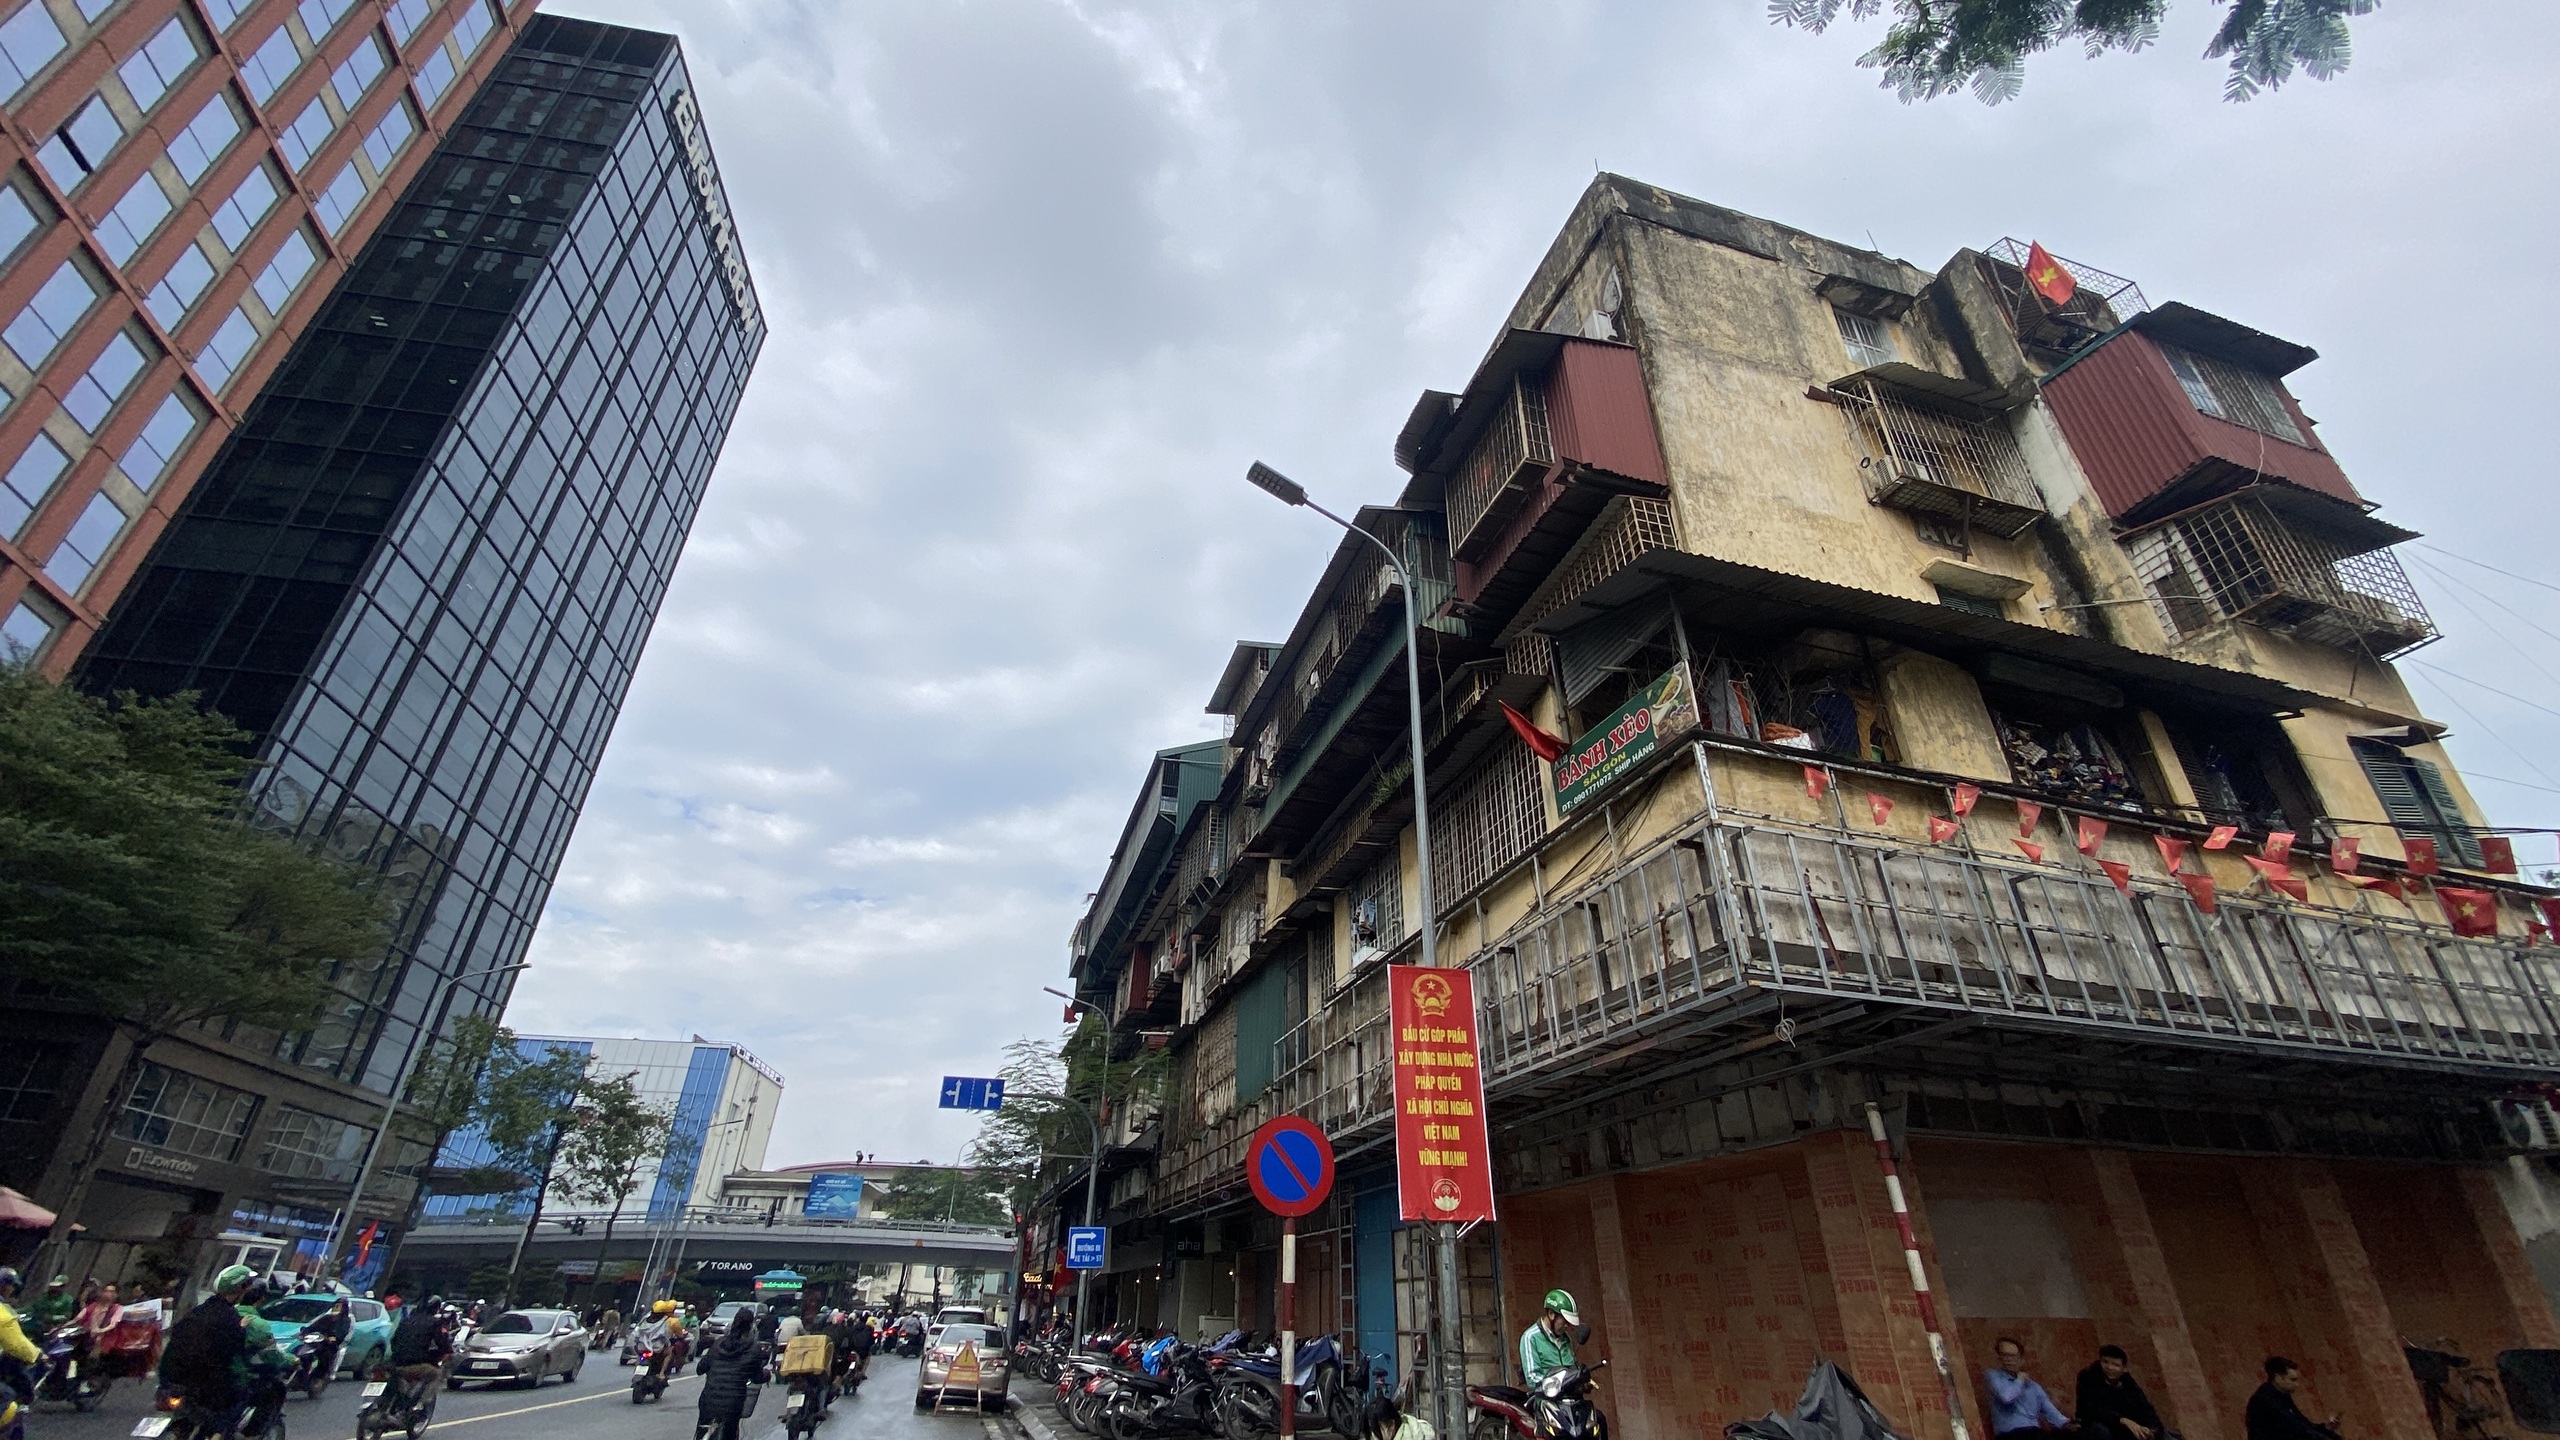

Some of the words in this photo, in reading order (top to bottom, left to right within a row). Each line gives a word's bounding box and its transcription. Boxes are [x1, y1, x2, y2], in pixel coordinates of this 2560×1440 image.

[1556, 738, 1608, 793] BÁNH
[1614, 758, 1632, 775] SHIP
[1430, 1026, 1446, 1043] GÓP
[1398, 1048, 1414, 1066] XÂY
[1415, 1050, 1437, 1069] DỰNG
[1437, 1050, 1453, 1067] NHÀ
[1454, 1051, 1475, 1068] NƯỚC
[1415, 1072, 1436, 1090] PHÁP
[1406, 1097, 1418, 1115] XÃ
[1418, 1096, 1432, 1118] HỘI
[1433, 1095, 1449, 1115] CHỦ
[1450, 1098, 1474, 1116] NGHĨA
[1423, 1122, 1440, 1143] VIỆT
[1441, 1125, 1460, 1141] NAM
[1418, 1147, 1441, 1166] VỮNG
[1441, 1150, 1468, 1169] MẠNH!
[1177, 1235, 1201, 1250] aha
[710, 1261, 753, 1271] TORANO
